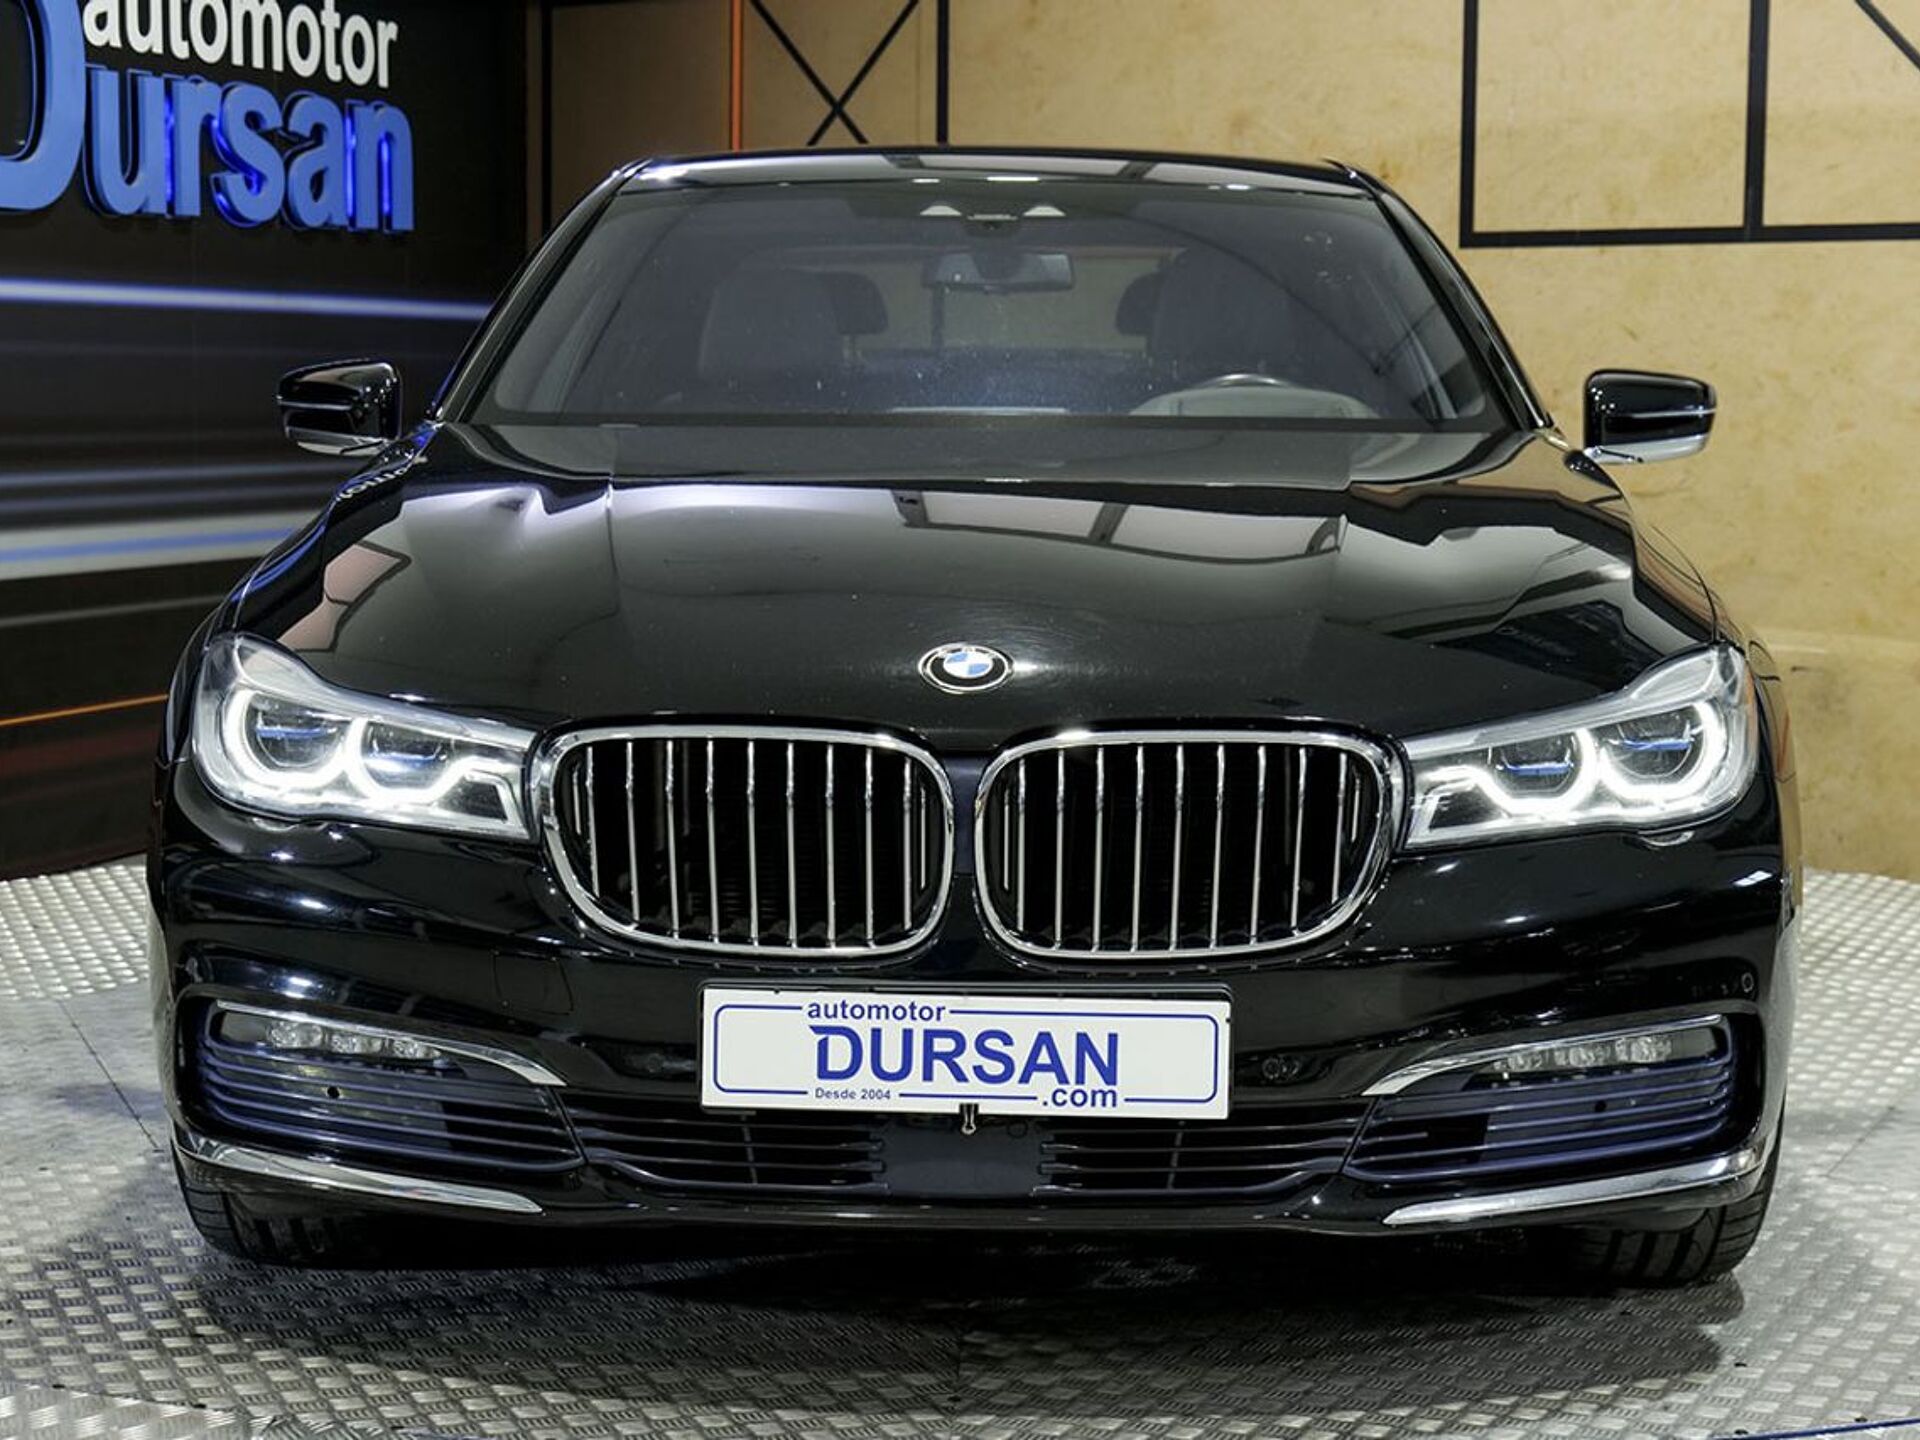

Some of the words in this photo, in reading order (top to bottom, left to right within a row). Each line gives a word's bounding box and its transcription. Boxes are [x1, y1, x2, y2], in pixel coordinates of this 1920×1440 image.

[83, 0, 398, 87] automotor
[807, 1000, 946, 1021] automotor
[808, 1025, 1118, 1086] DURSAN
[815, 1087, 856, 1099] Desde
[861, 1089, 891, 1100] 2004
[1042, 1088, 1117, 1108] .com
